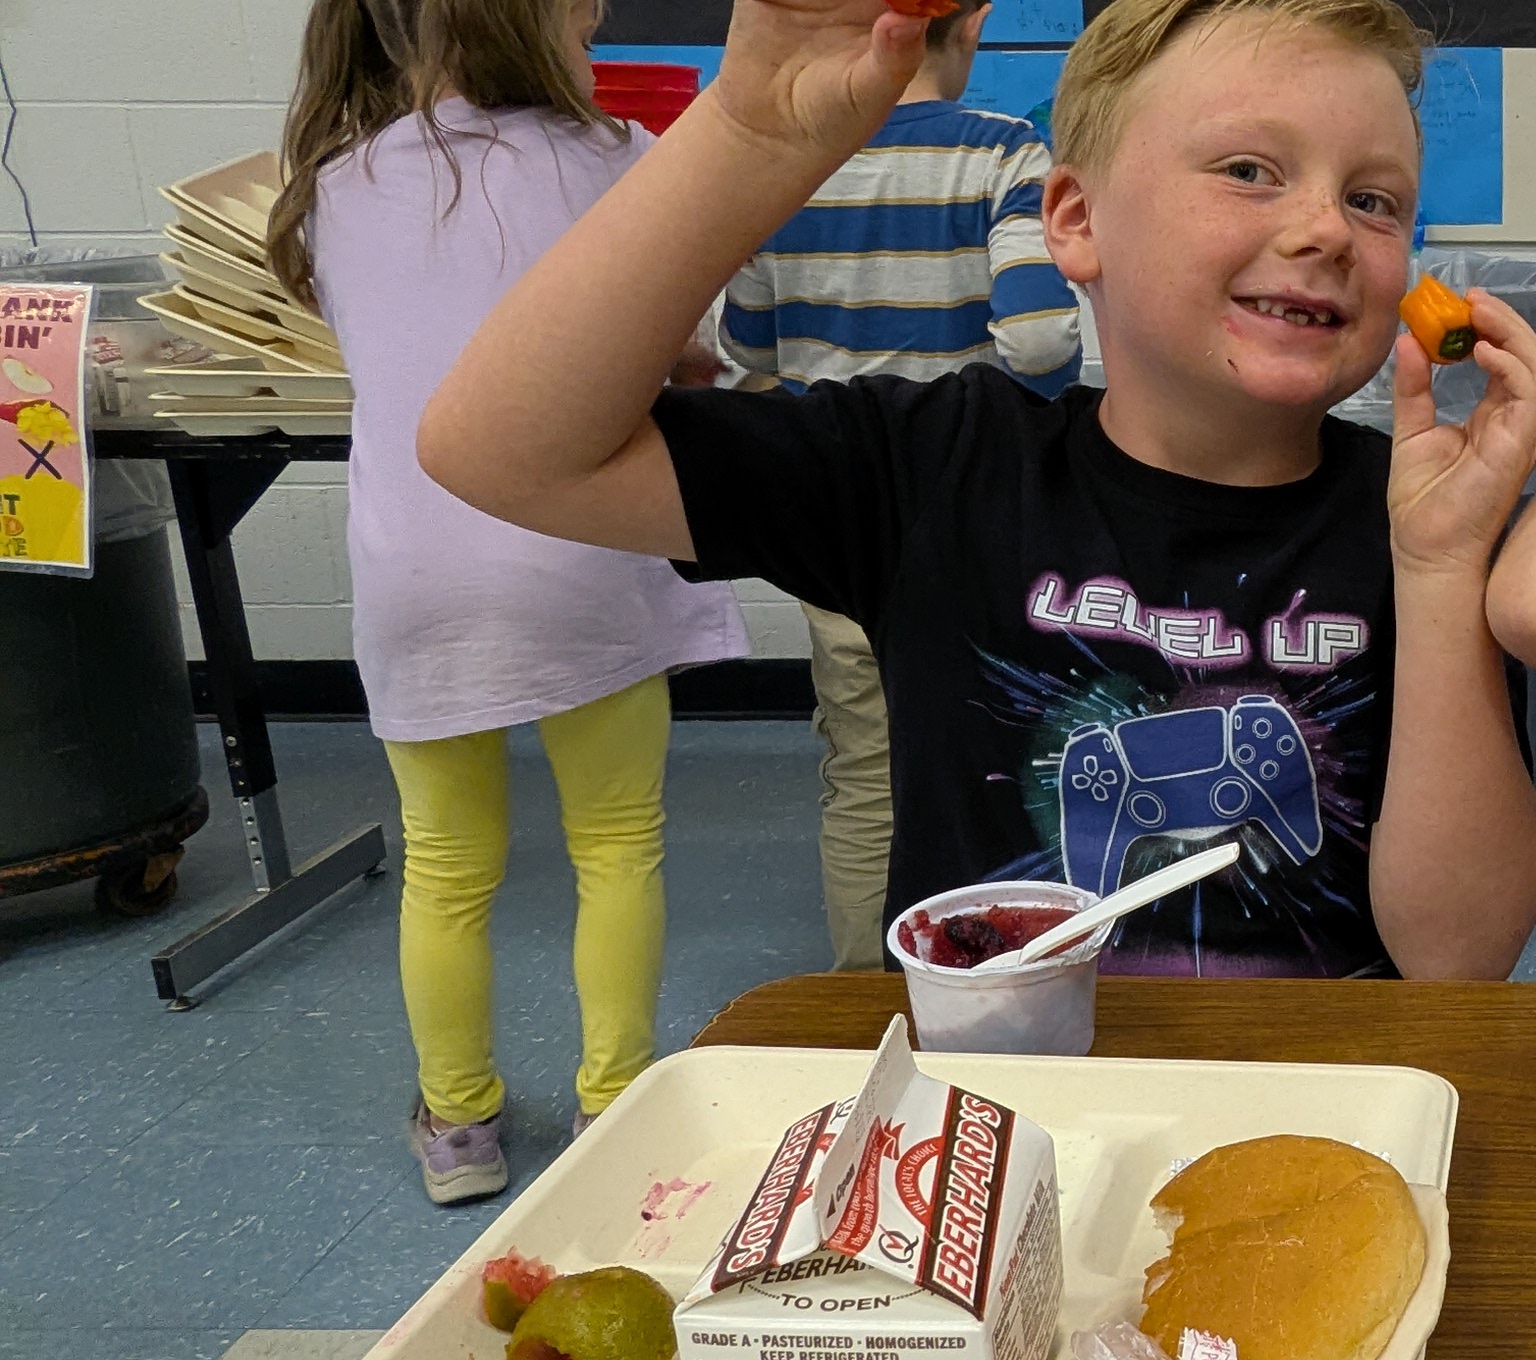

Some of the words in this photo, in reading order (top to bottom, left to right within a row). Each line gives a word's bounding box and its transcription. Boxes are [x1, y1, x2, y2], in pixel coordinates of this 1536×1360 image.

[1032, 579, 1243, 659] LEVEL
[1271, 618, 1363, 665] UP
[901, 1162, 917, 1199] LOCAL'S
[912, 1201, 928, 1217] THE
[933, 1094, 1002, 1307] EBERHARD'S
[782, 1293, 814, 1311] TO
[820, 1294, 892, 1313] OPEN
[691, 1332, 738, 1347] GRADE
[741, 1333, 752, 1348] A
[762, 1334, 854, 1349] PASTEURIZED
[865, 1336, 967, 1350] HOMOGENIZED
